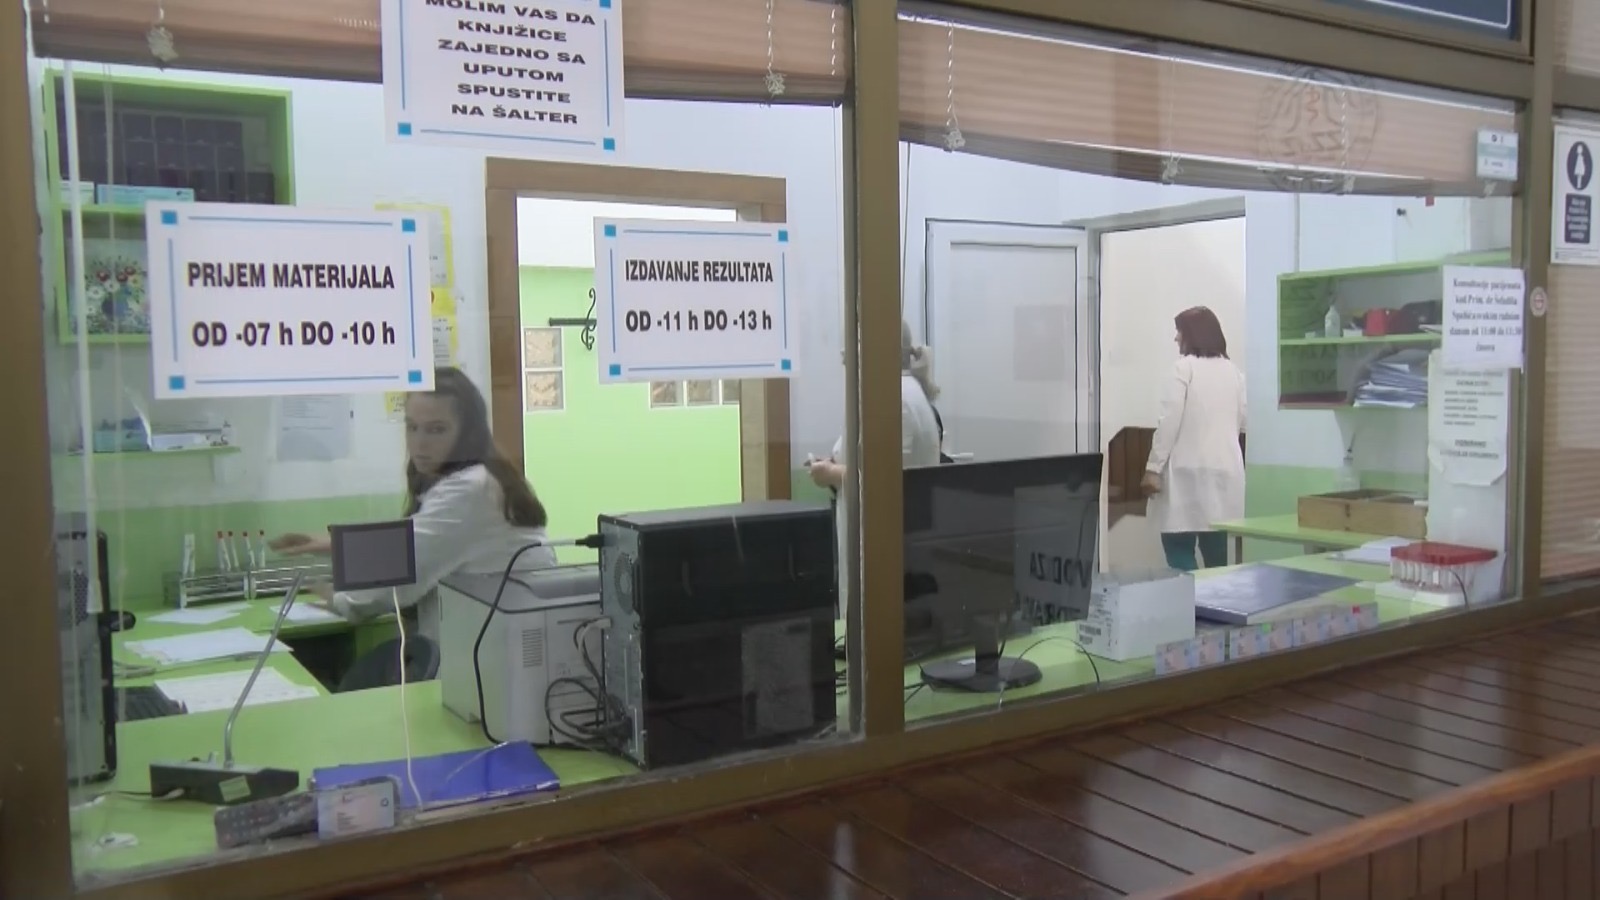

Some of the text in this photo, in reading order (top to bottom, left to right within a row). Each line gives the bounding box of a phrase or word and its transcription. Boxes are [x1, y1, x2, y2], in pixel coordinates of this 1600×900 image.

[425, 0, 596, 26] MOLIM VAS DA
[457, 19, 568, 42] KNJIŽICE
[438, 39, 587, 65] ZAJEDNO SA
[463, 62, 565, 83] UPUTOM
[457, 83, 571, 104] SPUSTITE
[451, 104, 578, 125] NA ŠALTER
[187, 262, 395, 289] PRIJEM MATERIJALA
[625, 259, 774, 283] IZDAVANJE REZULTATA
[625, 310, 651, 332] OD
[688, 310, 699, 331] h
[704, 309, 728, 331] DO
[762, 310, 772, 330] h
[192, 321, 228, 347] OD
[279, 321, 293, 346] h
[301, 321, 334, 346] DO
[382, 321, 396, 345] h
